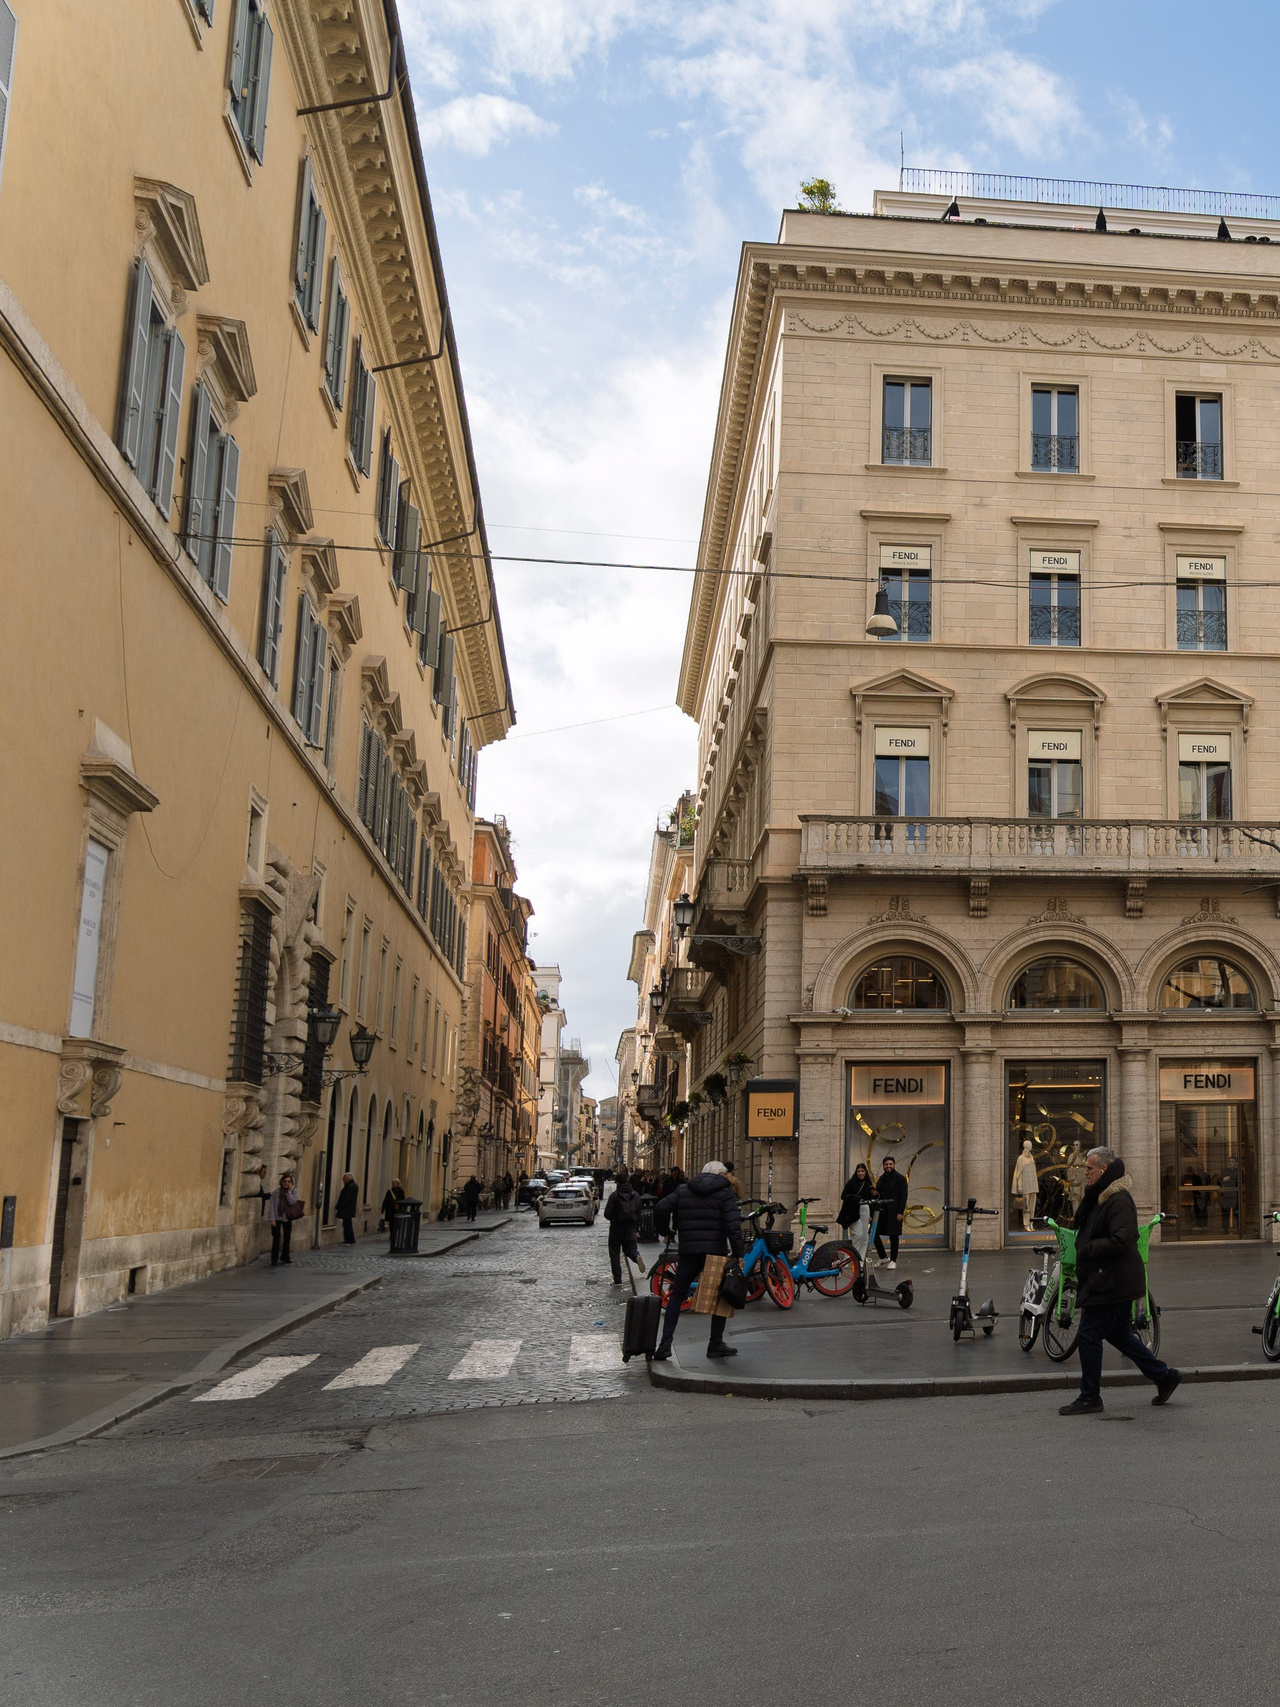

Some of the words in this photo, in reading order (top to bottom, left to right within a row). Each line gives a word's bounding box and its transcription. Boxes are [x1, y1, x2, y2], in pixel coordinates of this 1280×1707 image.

[892, 551, 918, 560] FENDI
[1042, 556, 1068, 565] FENDI
[1189, 562, 1214, 571] FENDI
[889, 738, 916, 748] FENDI
[1041, 742, 1068, 751] FENDI
[1192, 745, 1217, 753] FENDI
[1183, 1073, 1231, 1089] FENDI
[873, 1078, 923, 1094] FENDI
[757, 1108, 786, 1118] FENDI
[802, 1247, 813, 1266] dott
